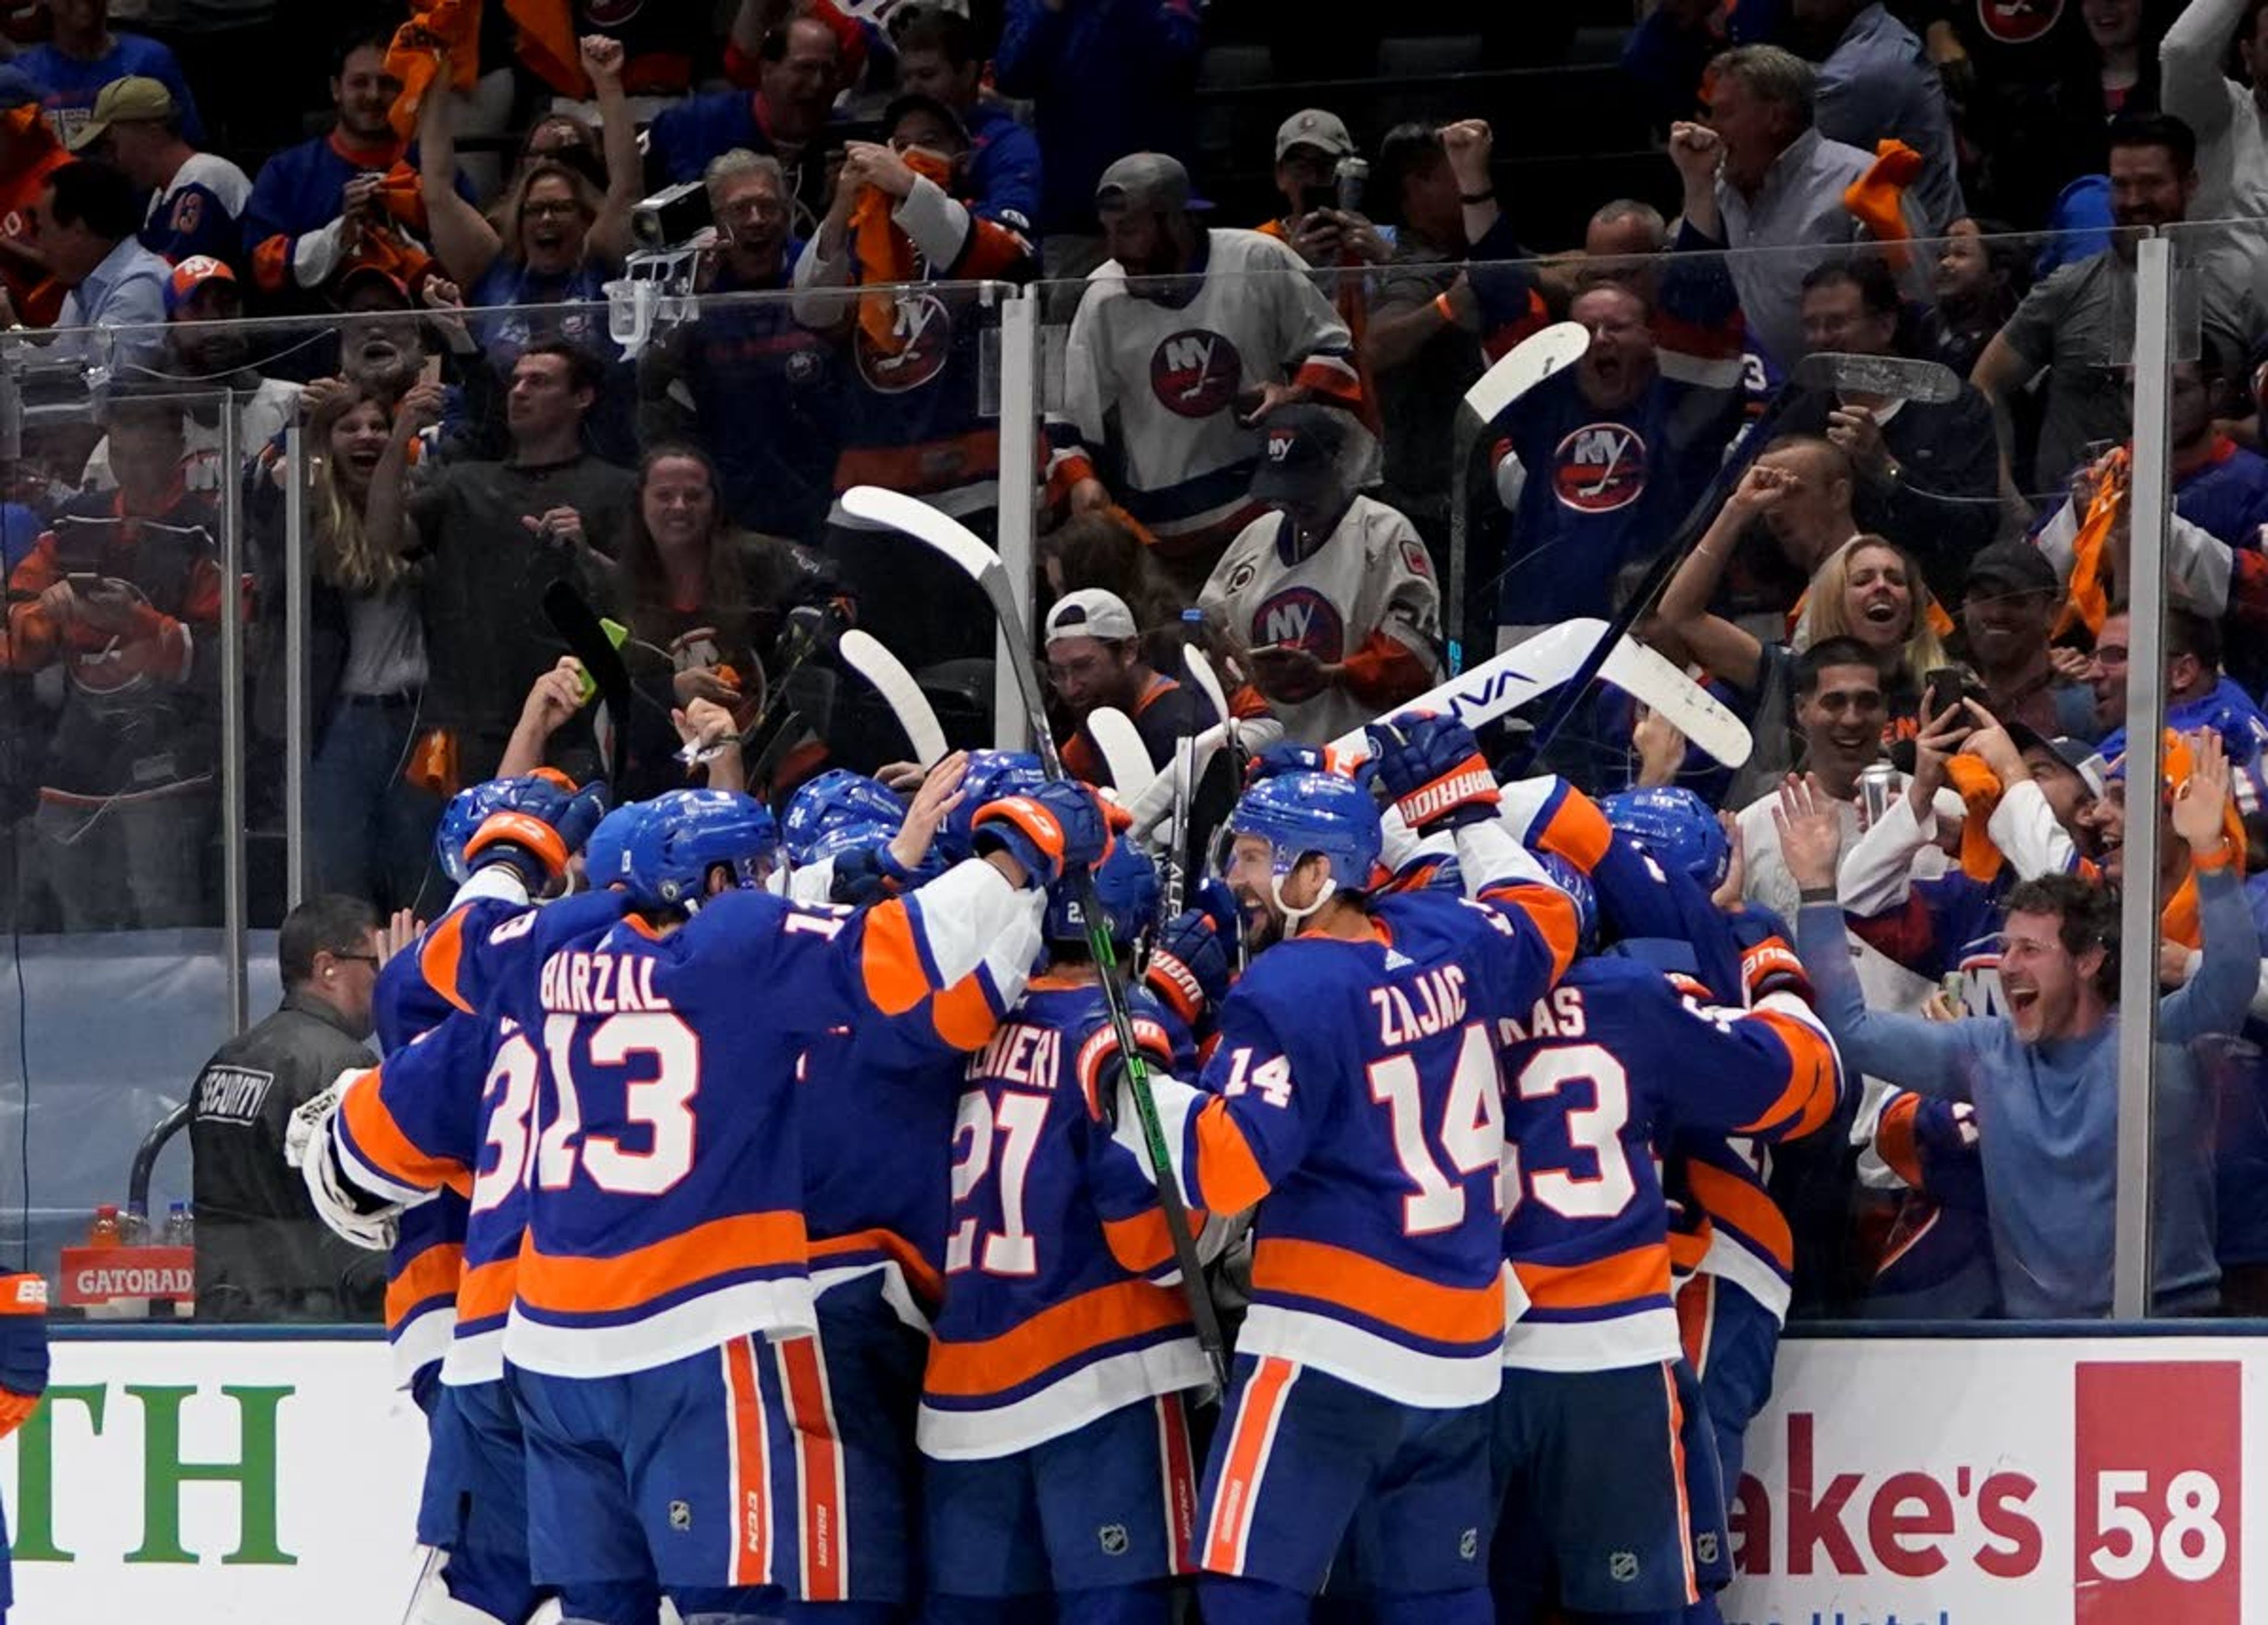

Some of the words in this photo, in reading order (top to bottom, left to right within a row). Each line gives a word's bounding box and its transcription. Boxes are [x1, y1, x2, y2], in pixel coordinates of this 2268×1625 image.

[1575, 430, 1631, 465] NY
[540, 951, 670, 1012] BARZAL
[1370, 965, 1467, 1047] ZAJAC
[199, 1070, 267, 1118] SECURITY
[537, 1011, 699, 1196] 13
[1224, 1047, 1292, 1108] 14
[1364, 1022, 1506, 1236] 14
[1495, 1043, 1636, 1220] 3
[944, 1088, 1040, 1278] 21
[77, 1269, 193, 1294] GATORAD
[2089, 1470, 2227, 1581] 58
